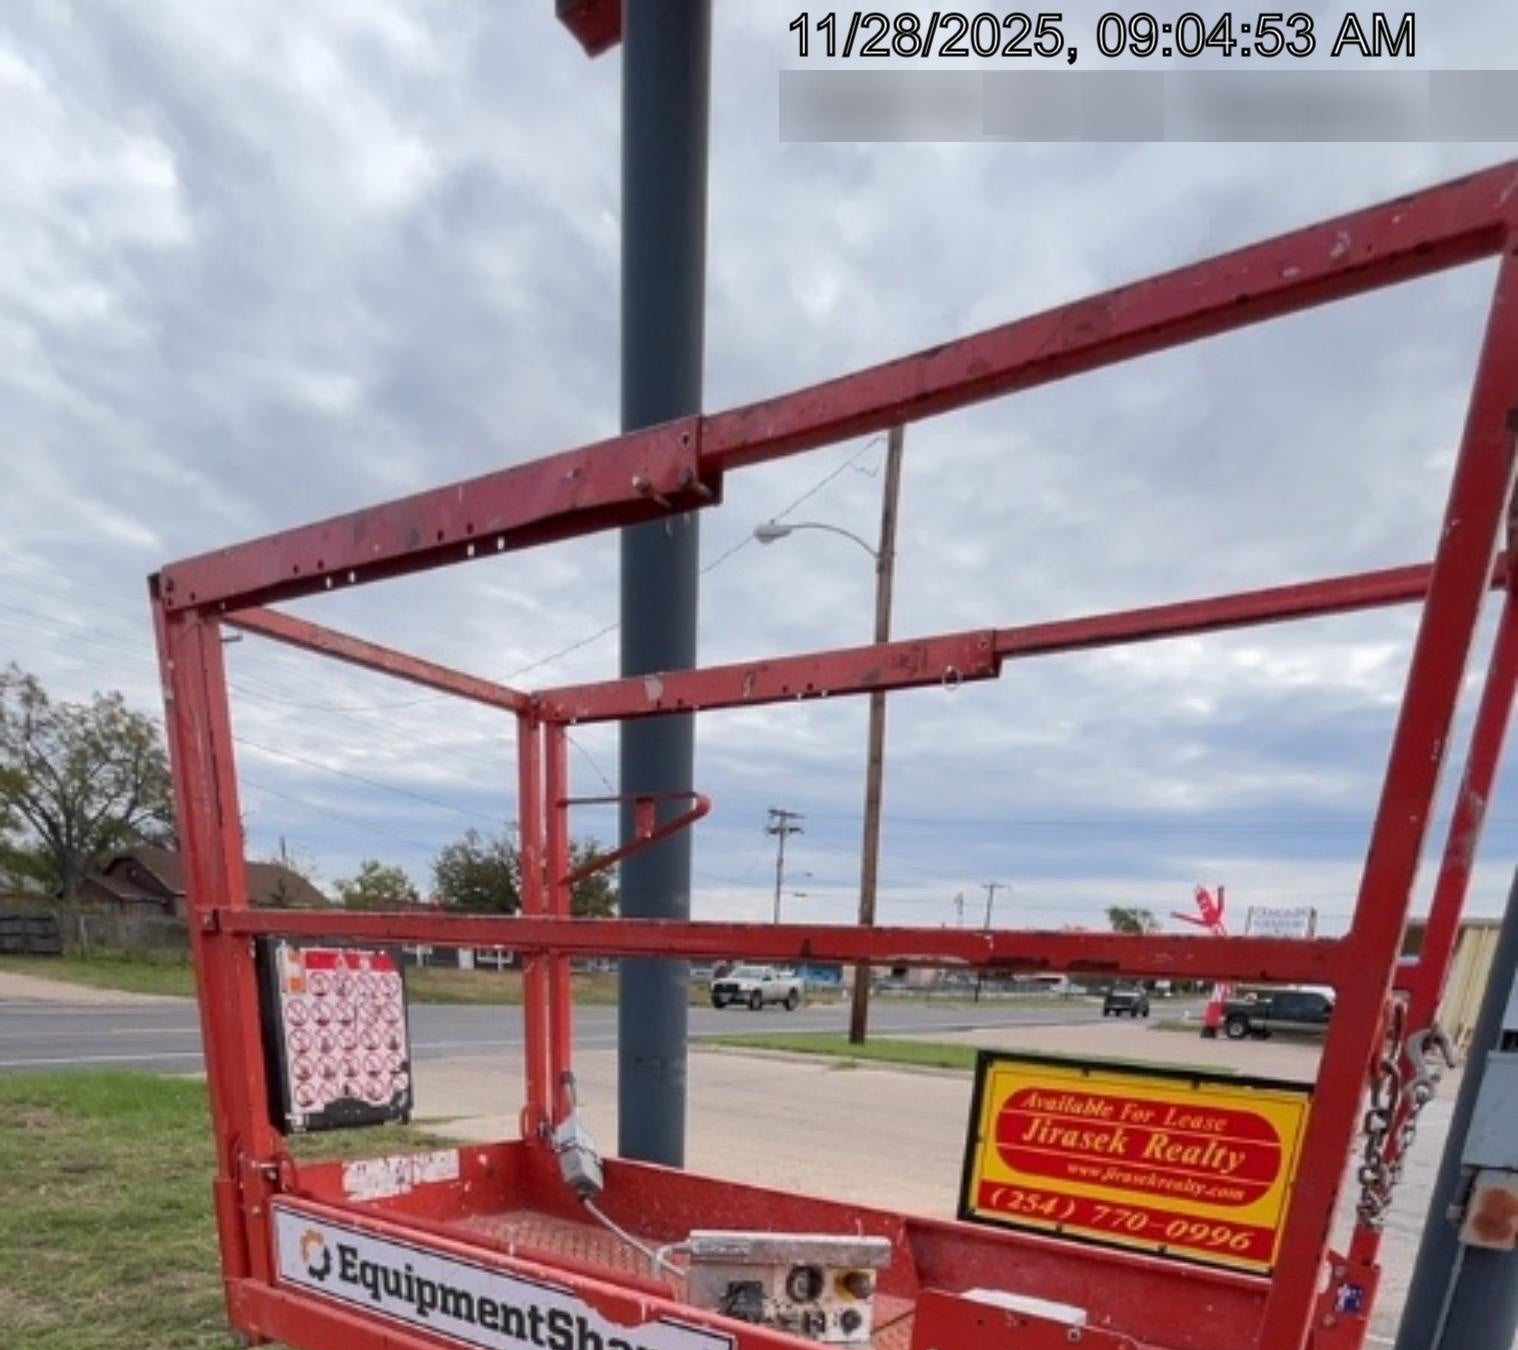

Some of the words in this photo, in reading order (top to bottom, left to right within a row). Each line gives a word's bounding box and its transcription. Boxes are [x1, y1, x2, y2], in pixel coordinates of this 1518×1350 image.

[1022, 1091, 1114, 1118] Available
[1120, 1104, 1156, 1124] For
[1163, 1107, 1228, 1133] Lease
[1022, 1115, 1131, 1155] Jirasek
[1143, 1133, 1246, 1174] Realty
[1066, 1160, 1246, 1202] www.jirasekrealty.com
[990, 1187, 1076, 1221] (254)
[1091, 1204, 1253, 1250] 770-0996
